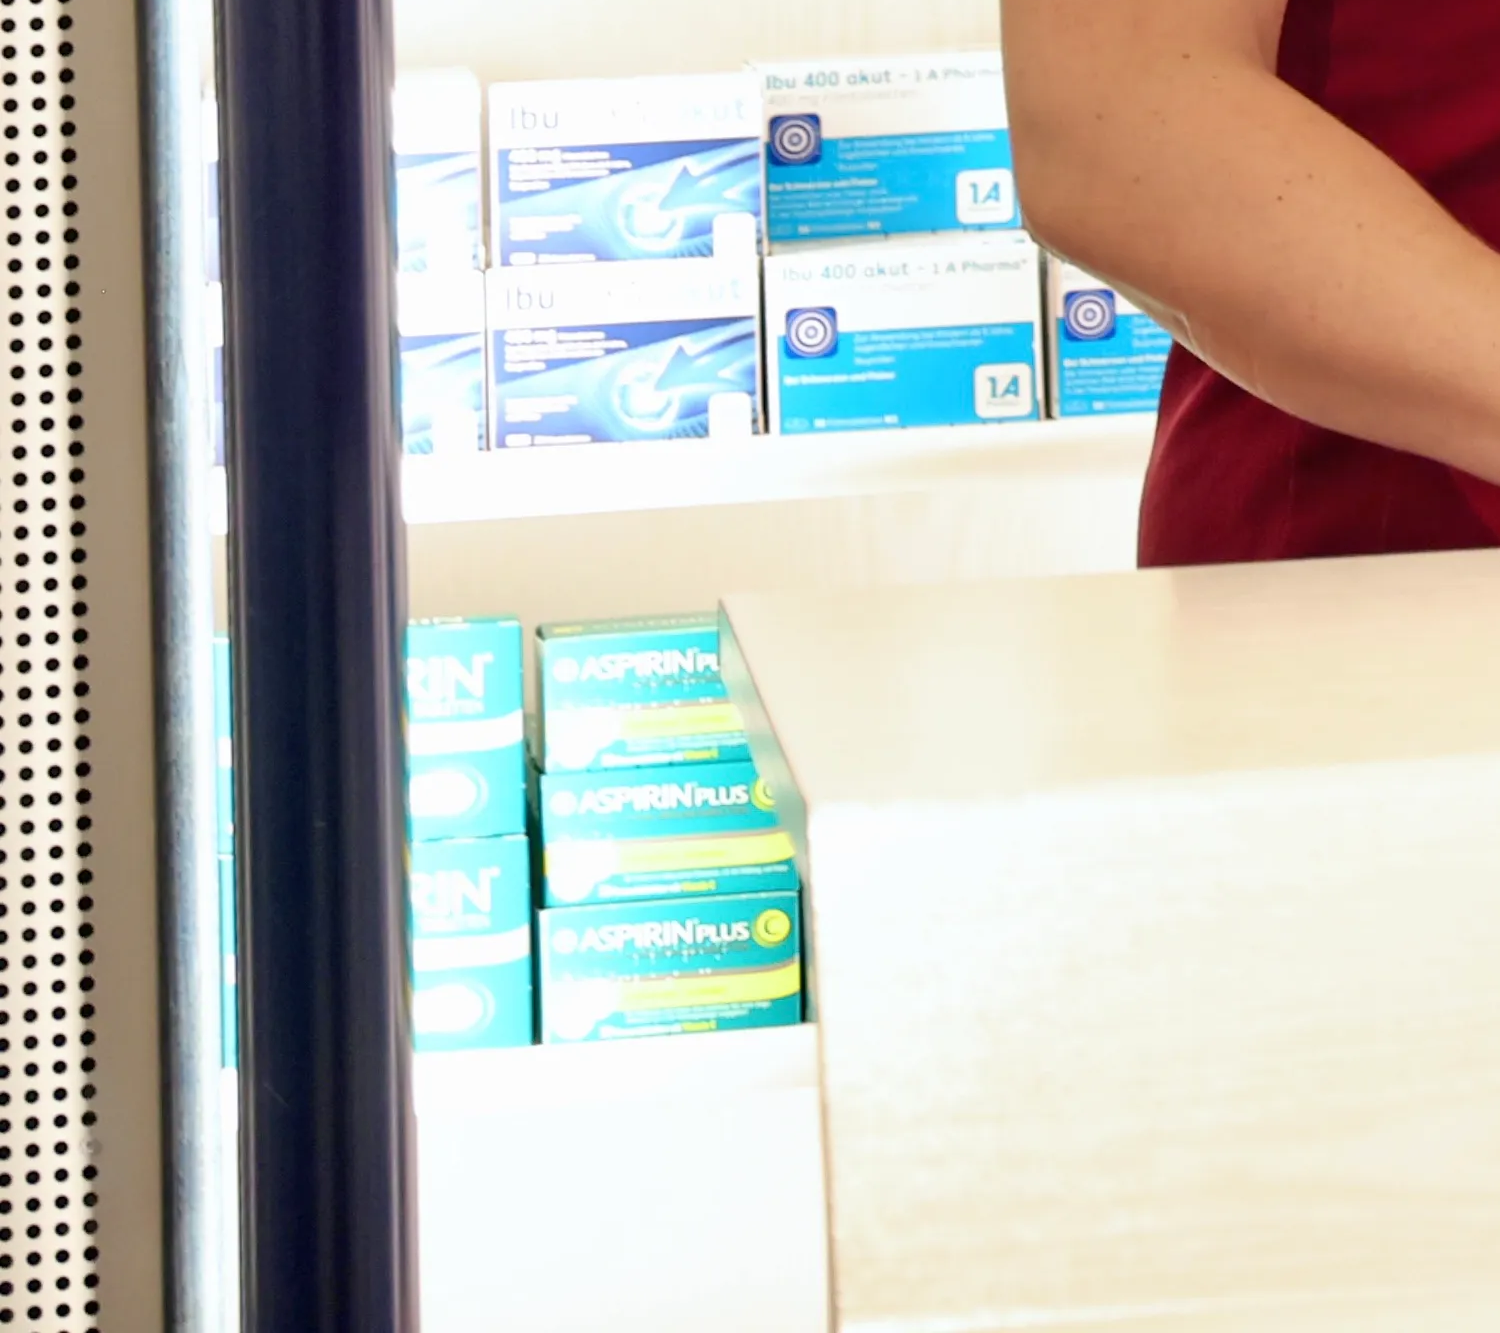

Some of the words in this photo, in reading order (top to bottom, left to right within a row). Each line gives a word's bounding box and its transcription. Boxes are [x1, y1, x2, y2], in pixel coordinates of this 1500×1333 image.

[766, 75, 797, 90] Ibu
[804, 71, 840, 87] 400
[847, 68, 892, 86] akut
[510, 103, 560, 130] Ibu
[782, 266, 813, 283] Ibu
[820, 262, 857, 280] 400
[864, 261, 910, 278] akut
[505, 285, 555, 312] Ibu
[580, 647, 694, 682] ASPIRIN
[577, 783, 692, 816] ASPIRIN
[695, 784, 749, 809] PLUS
[578, 920, 695, 955] ASPIRIN
[698, 921, 751, 944] PLUS
